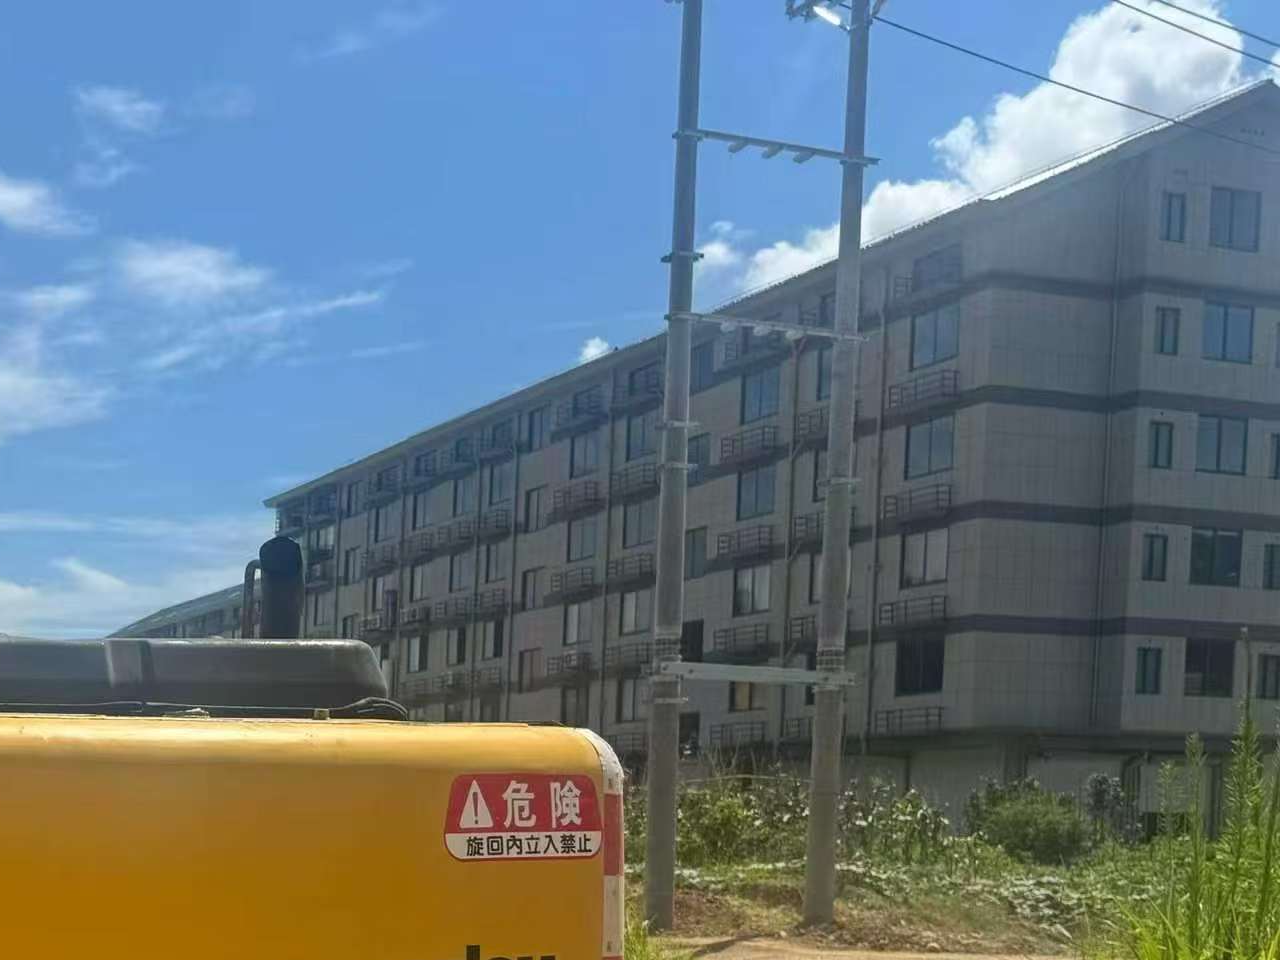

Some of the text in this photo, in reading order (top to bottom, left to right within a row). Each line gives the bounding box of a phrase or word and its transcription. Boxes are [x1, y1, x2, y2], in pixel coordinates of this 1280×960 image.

[502, 780, 582, 829] 危険
[466, 833, 593, 857] 旋回内立入禁止
